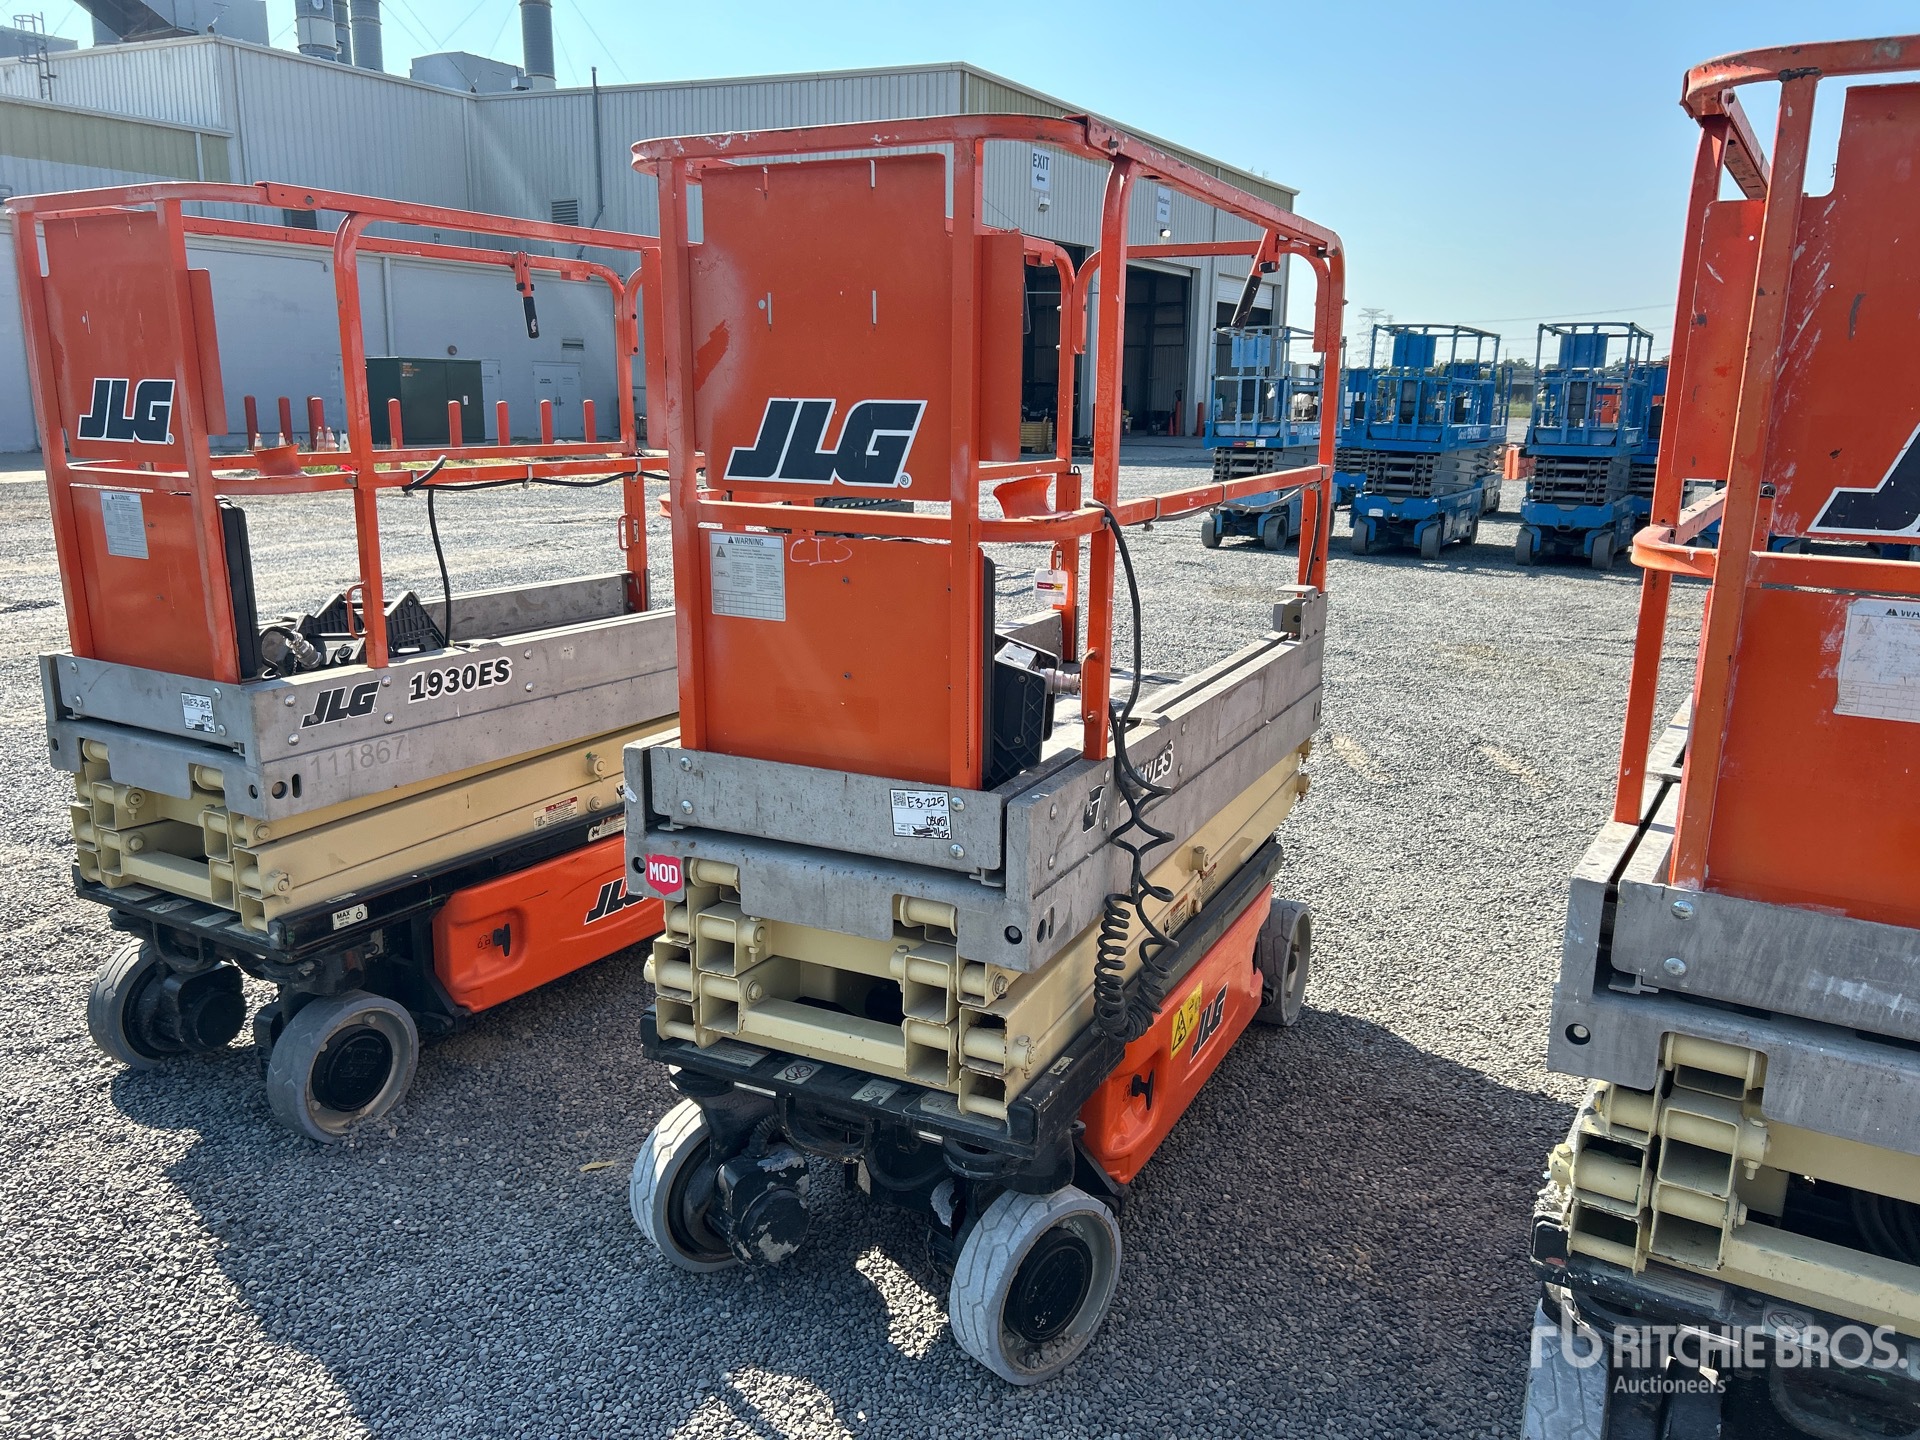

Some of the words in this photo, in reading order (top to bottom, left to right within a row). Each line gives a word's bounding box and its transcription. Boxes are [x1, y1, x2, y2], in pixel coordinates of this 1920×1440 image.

[1032, 152, 1050, 171] EXIT
[77, 377, 176, 445] JLG
[723, 397, 928, 488] JLG
[734, 536, 764, 547] WARNING
[300, 680, 381, 729] JLG
[409, 656, 513, 702] 1930ES
[310, 734, 406, 781] 111867
[649, 862, 679, 885] MOD
[336, 910, 351, 919] MAX
[584, 876, 647, 926] JL
[1189, 981, 1229, 1065] JLG
